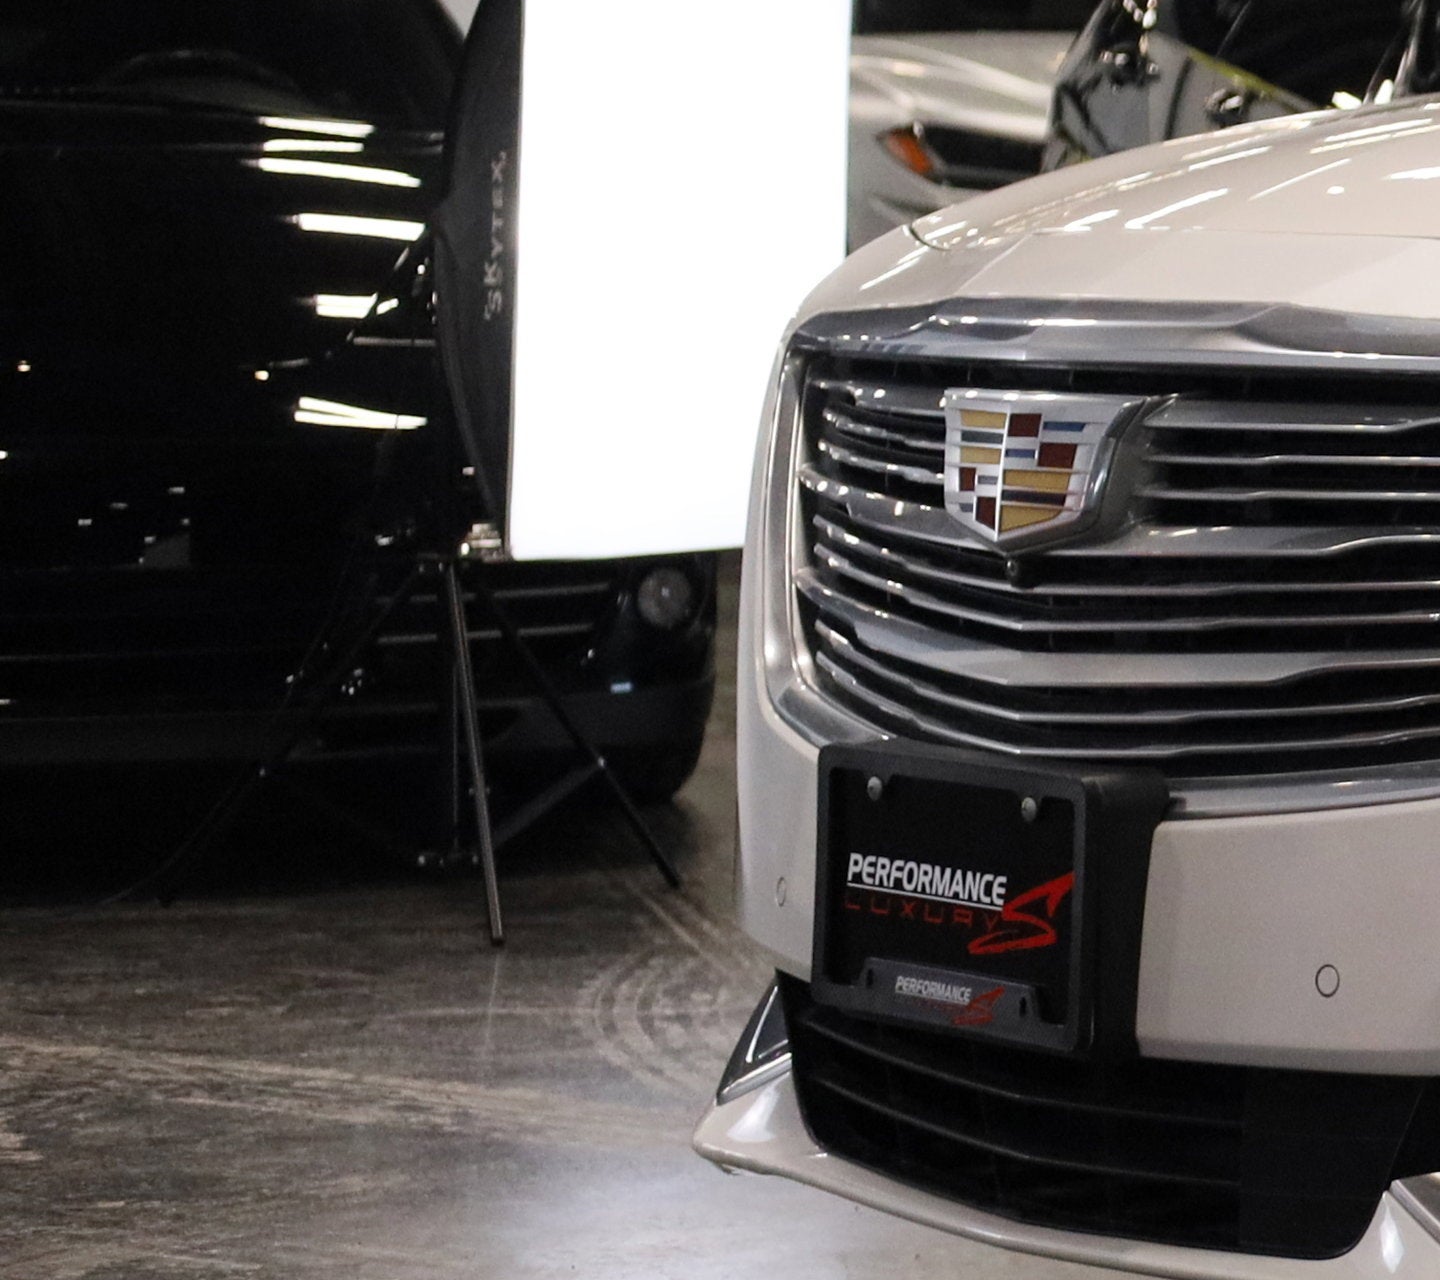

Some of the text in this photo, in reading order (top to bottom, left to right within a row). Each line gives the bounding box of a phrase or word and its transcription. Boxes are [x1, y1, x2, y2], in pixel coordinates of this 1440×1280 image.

[484, 157, 504, 320] SKYTEX
[848, 852, 1007, 906] PERFORMANCE
[845, 891, 1001, 931] LUXURY
[895, 976, 972, 1005] PERFORMANCE
